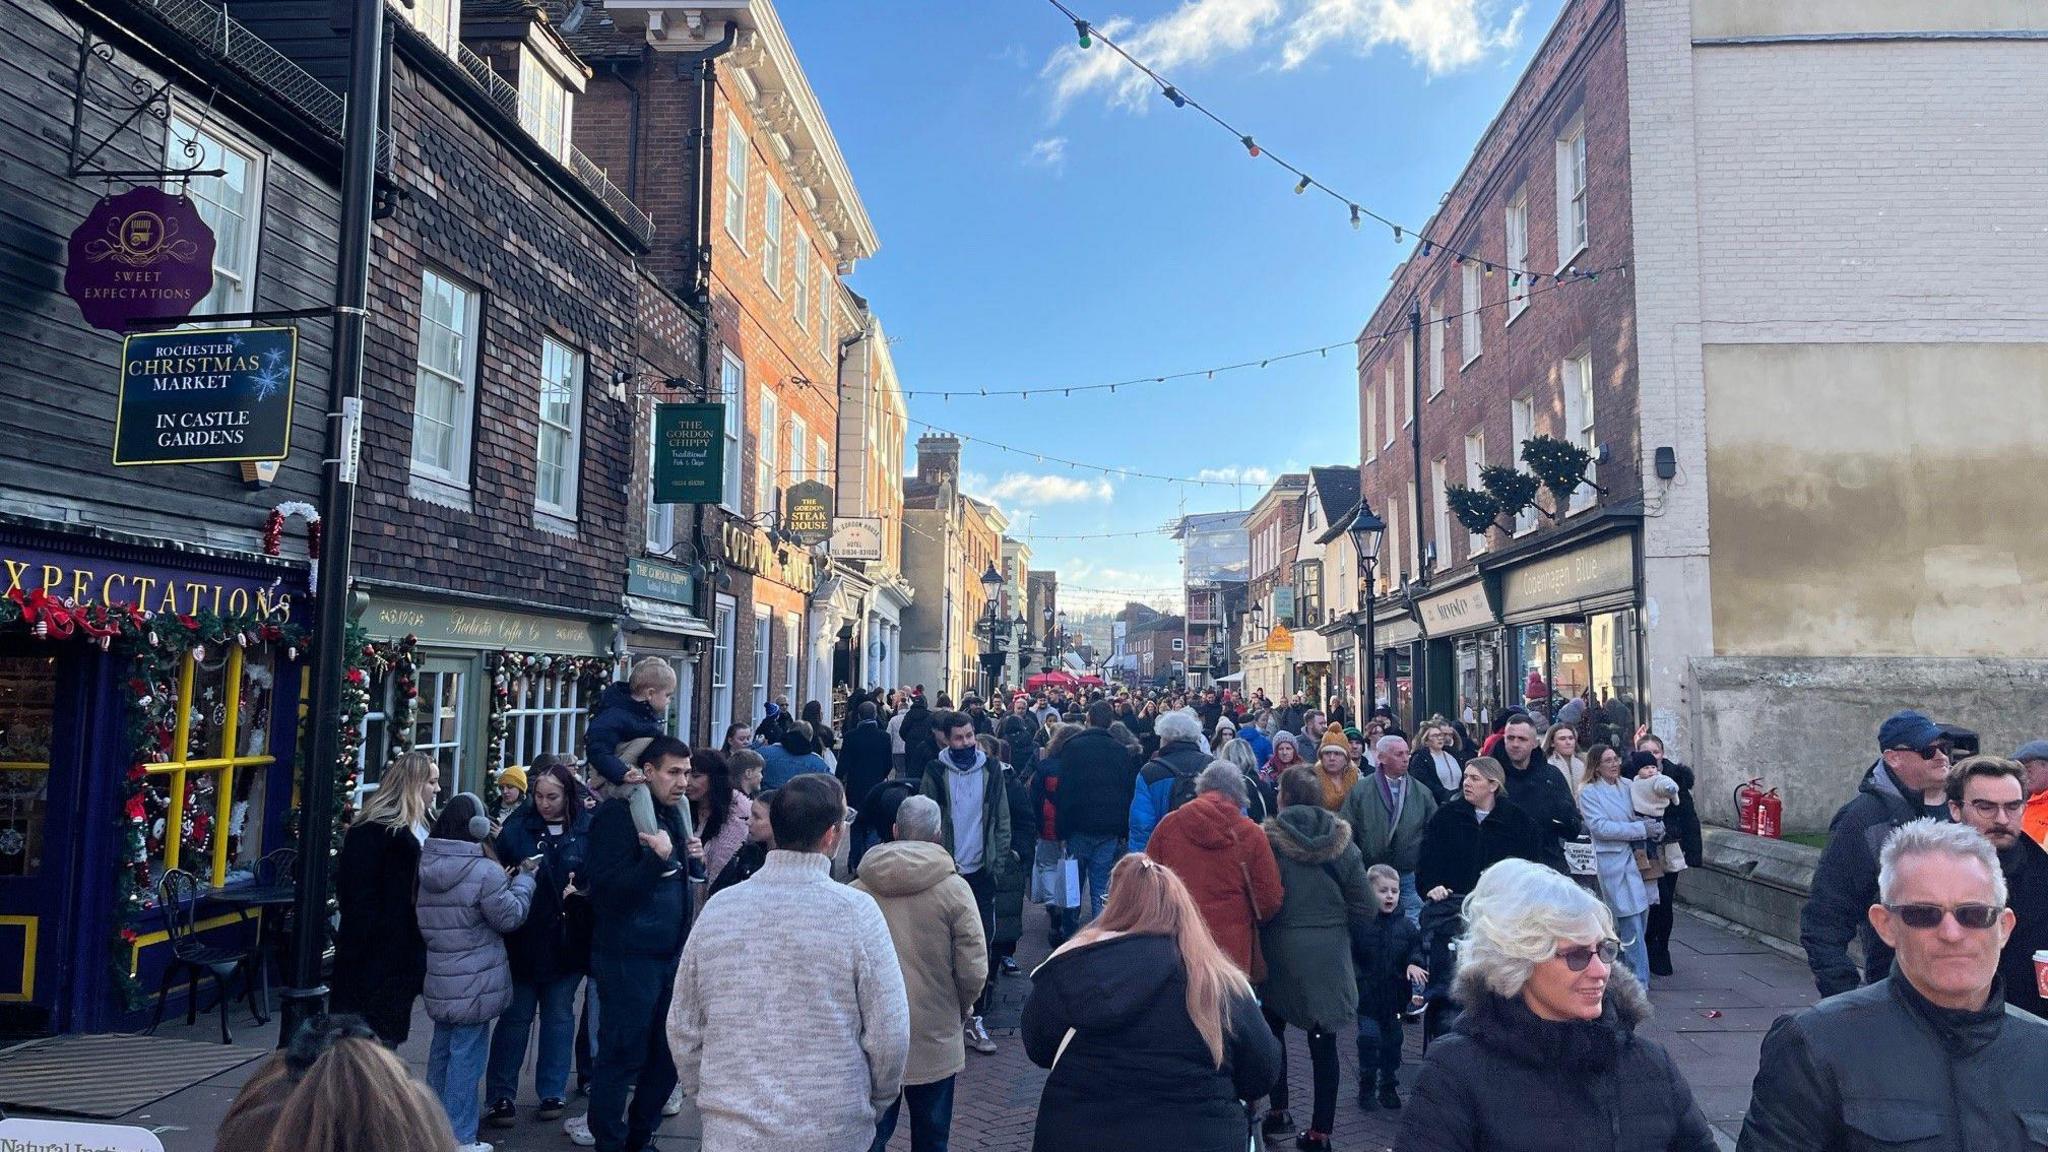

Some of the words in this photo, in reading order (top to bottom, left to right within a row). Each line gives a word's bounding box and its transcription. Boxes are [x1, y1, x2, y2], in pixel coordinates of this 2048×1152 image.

[115, 271, 162, 281] SWEET
[85, 287, 191, 299] EXPECTATIONS
[156, 344, 233, 357] ROCHESTER
[129, 355, 260, 376] CHRISTMAS
[153, 375, 232, 391] MARKET
[156, 413, 176, 429] IN
[180, 410, 250, 428] CASTLE
[678, 420, 703, 430] THE
[158, 430, 244, 447] GARDENS
[665, 430, 714, 439] GORDON
[669, 438, 710, 447] CHIPPY
[791, 511, 827, 521] STEAK
[790, 521, 829, 530] HOUSE
[636, 563, 648, 577] THE
[1523, 566, 1569, 598] Copenhagen
[1575, 556, 1598, 582] Blue
